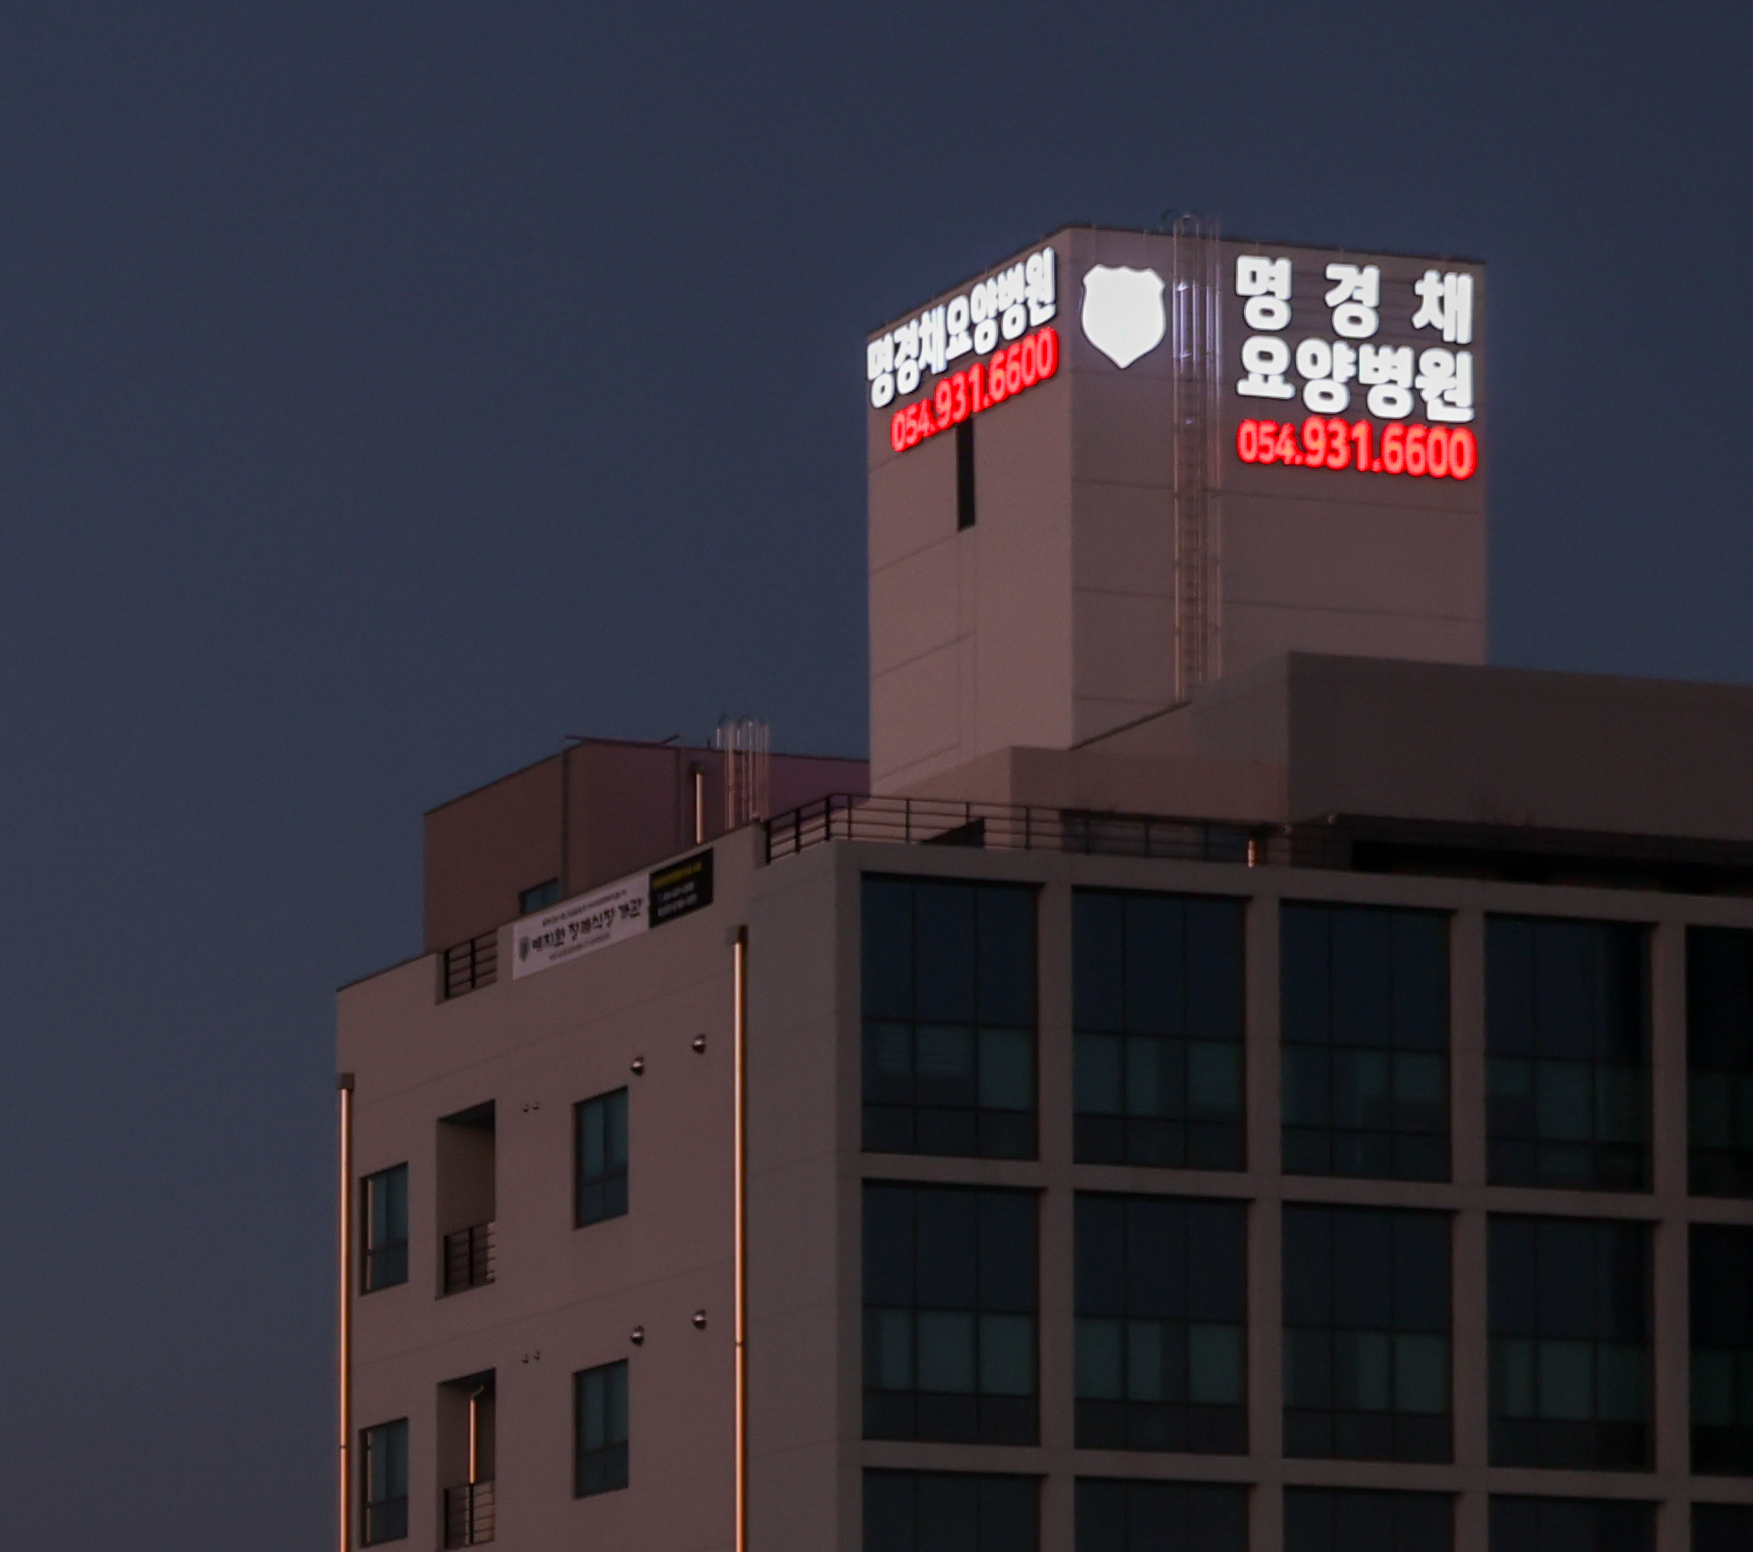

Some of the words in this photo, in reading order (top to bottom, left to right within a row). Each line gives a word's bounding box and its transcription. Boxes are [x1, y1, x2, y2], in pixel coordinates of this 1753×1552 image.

[867, 246, 1056, 408] 명경채요양병원
[1236, 335, 1475, 423] 요양병원
[890, 327, 1059, 452] 054.931.6600
[1236, 416, 1478, 480] 054.931.6600
